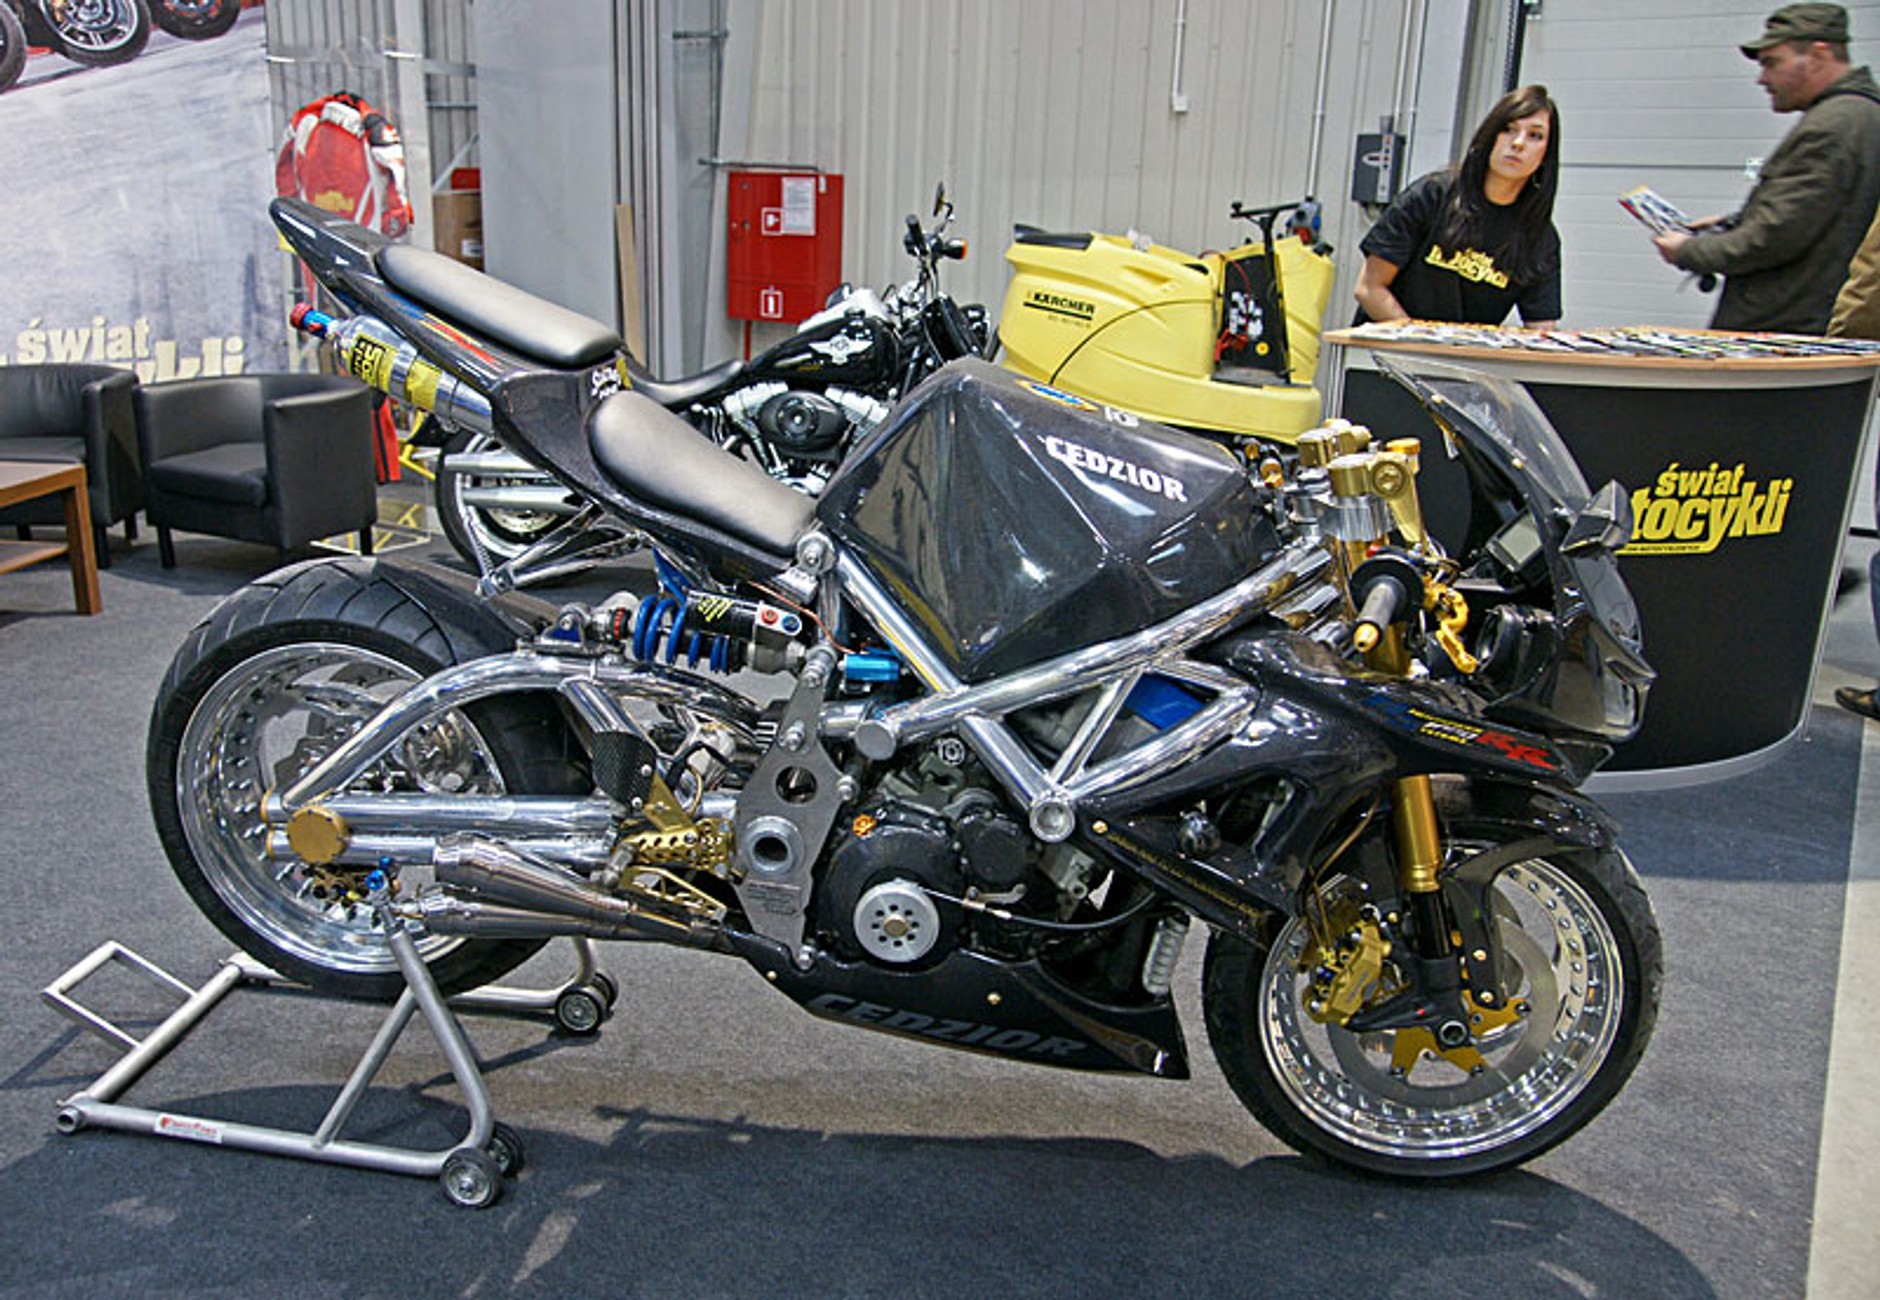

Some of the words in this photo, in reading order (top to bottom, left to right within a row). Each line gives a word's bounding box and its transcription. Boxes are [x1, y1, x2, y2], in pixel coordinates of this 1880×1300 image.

[17, 316, 150, 363] świat
[1044, 434, 1188, 503] CEDZIOR
[1654, 462, 1746, 497] świat
[807, 993, 1088, 1055] CEDZIOR
